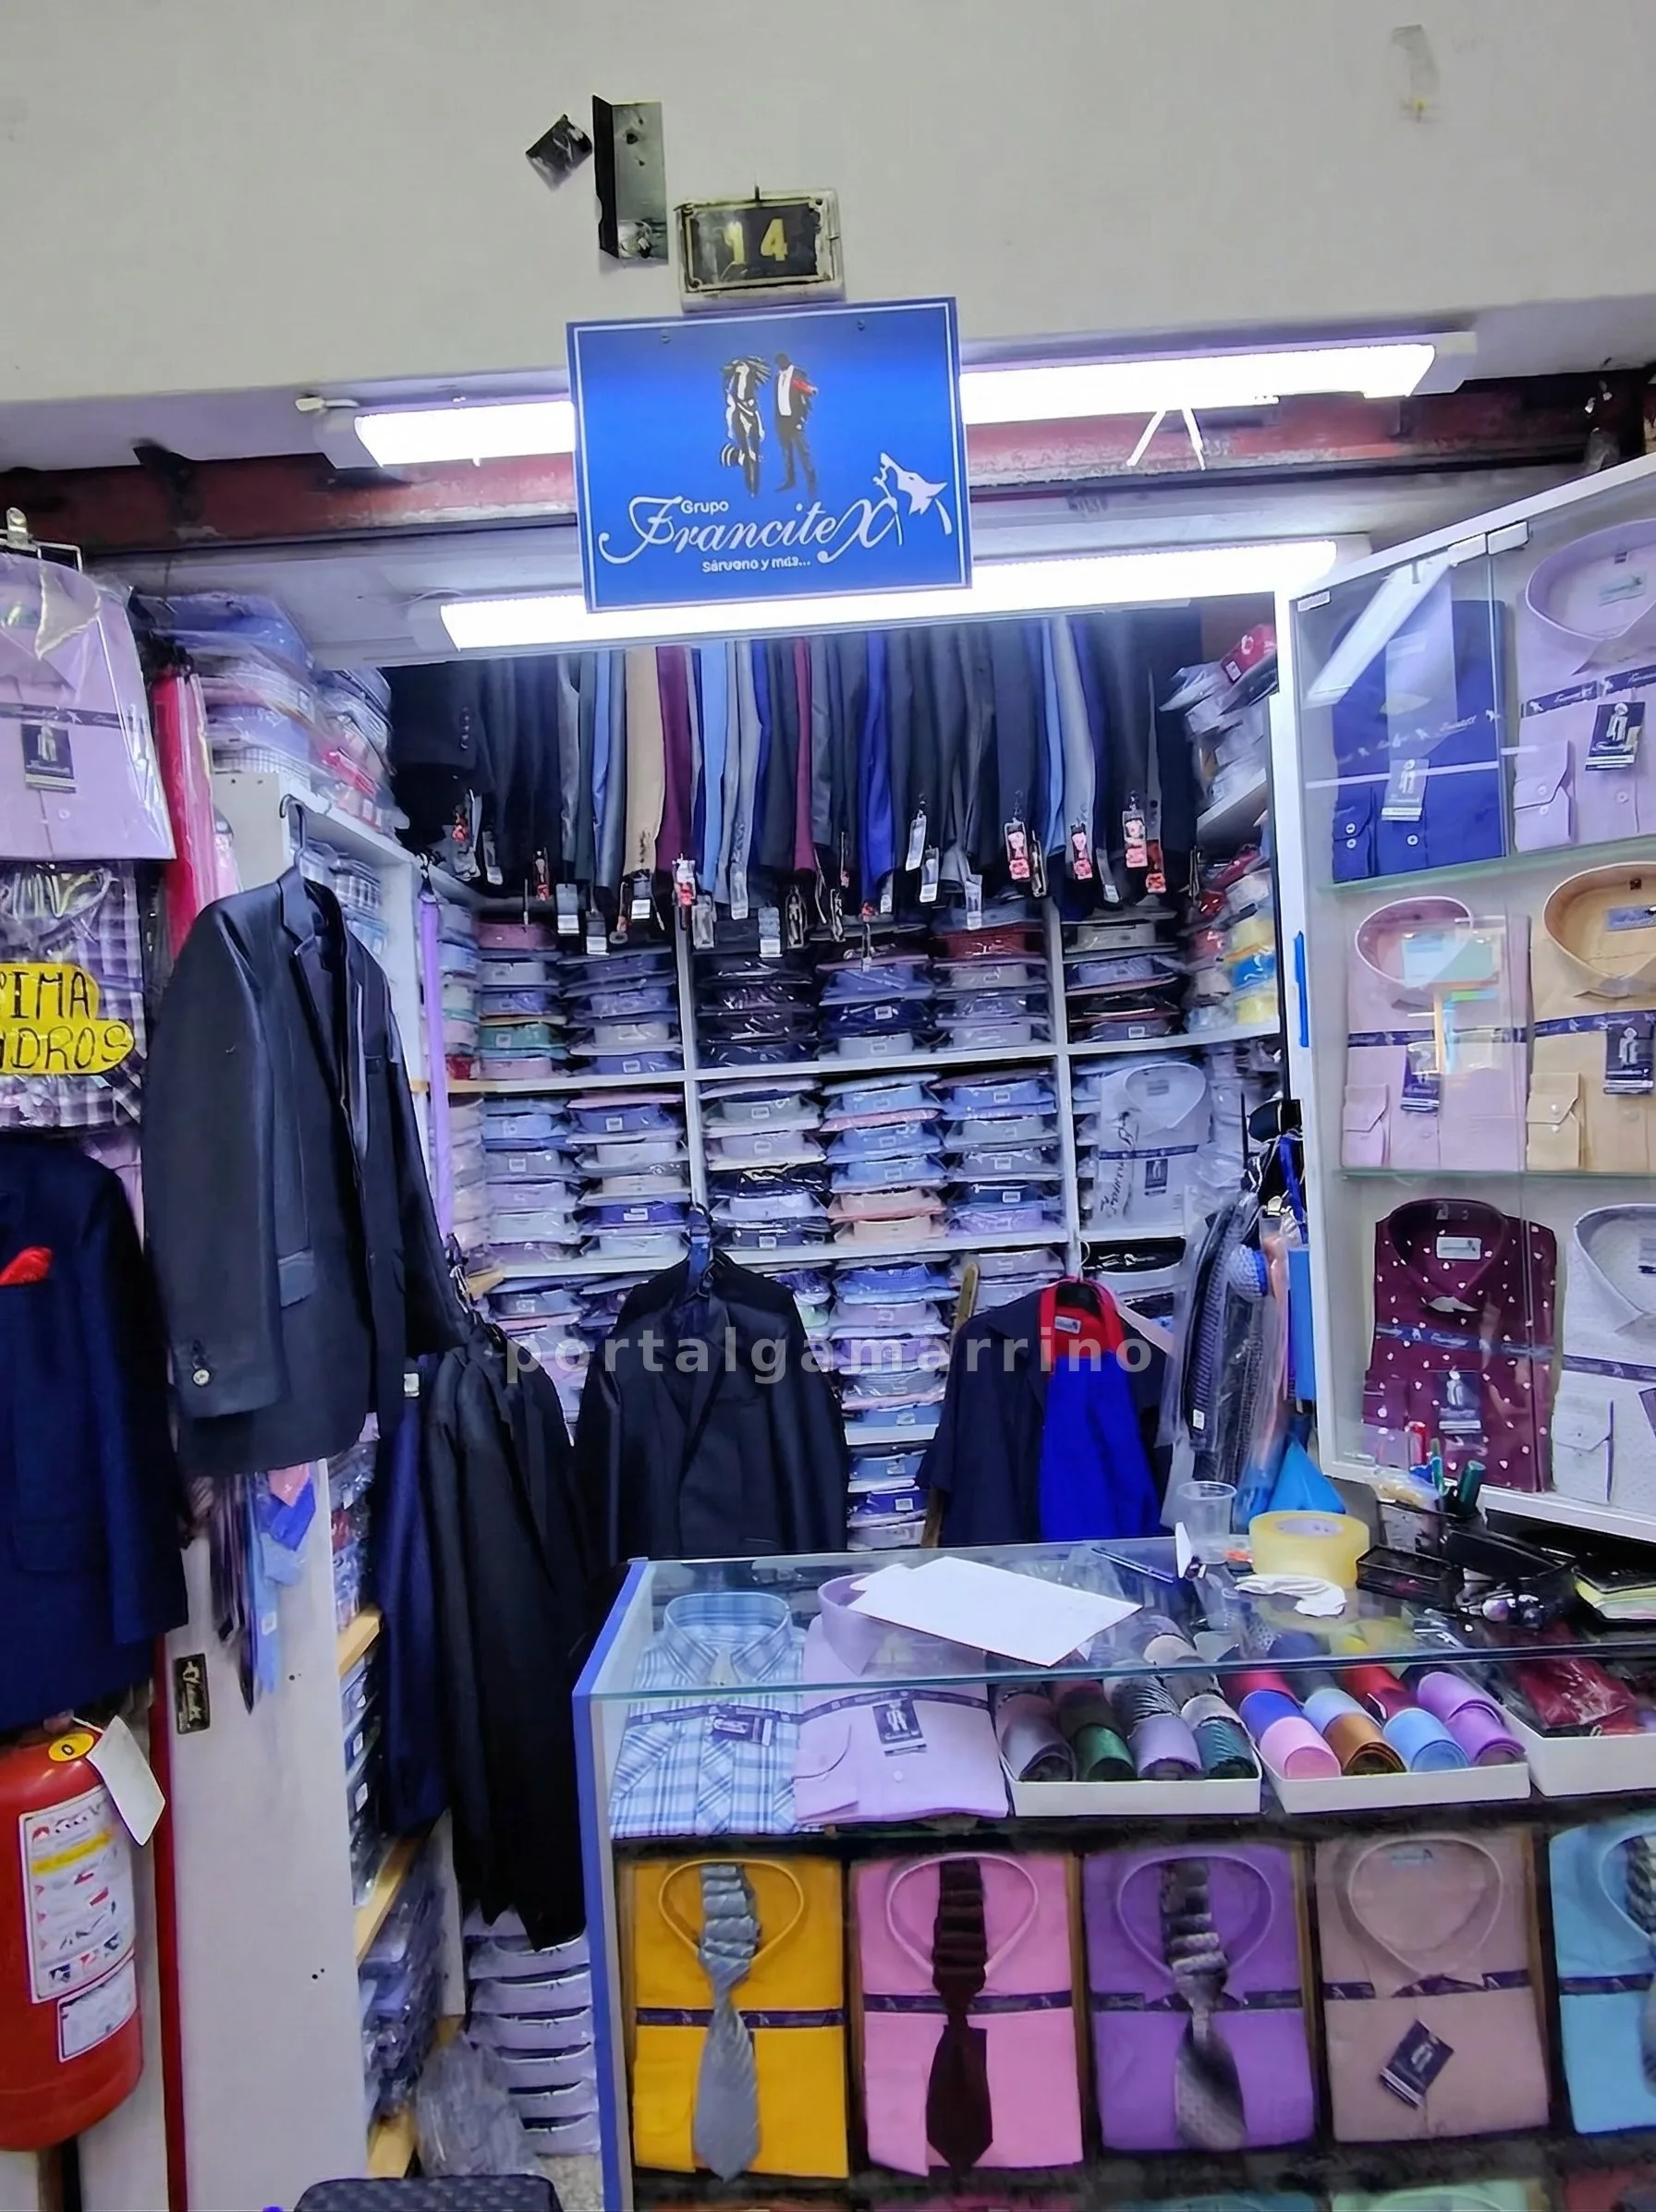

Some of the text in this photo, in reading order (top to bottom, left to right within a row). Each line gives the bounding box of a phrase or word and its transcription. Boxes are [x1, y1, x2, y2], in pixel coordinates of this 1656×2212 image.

[680, 499, 729, 515] Grupo
[761, 558, 770, 571] y
[0, 1025, 128, 1070] DROS
